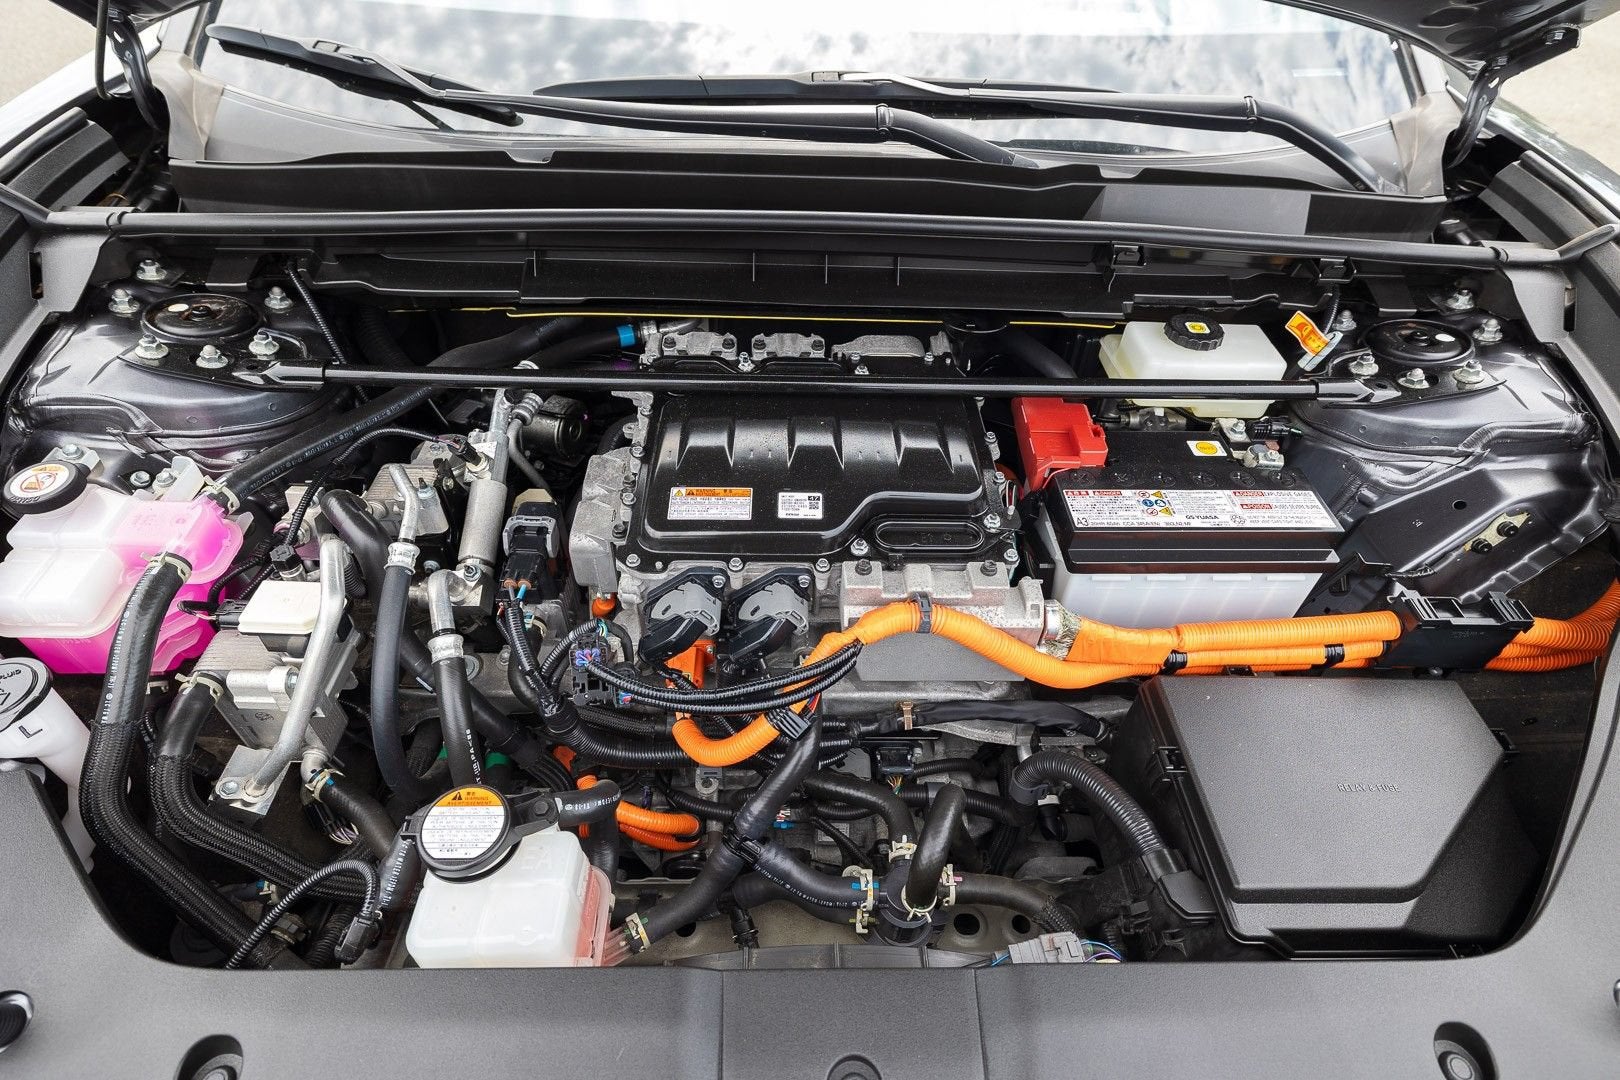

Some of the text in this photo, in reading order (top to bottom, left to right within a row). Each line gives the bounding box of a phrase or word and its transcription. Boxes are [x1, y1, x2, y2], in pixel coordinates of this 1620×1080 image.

[1076, 517, 1089, 527] A3
[1336, 784, 1366, 792] RELAY
[1375, 784, 1401, 792] FUSE
